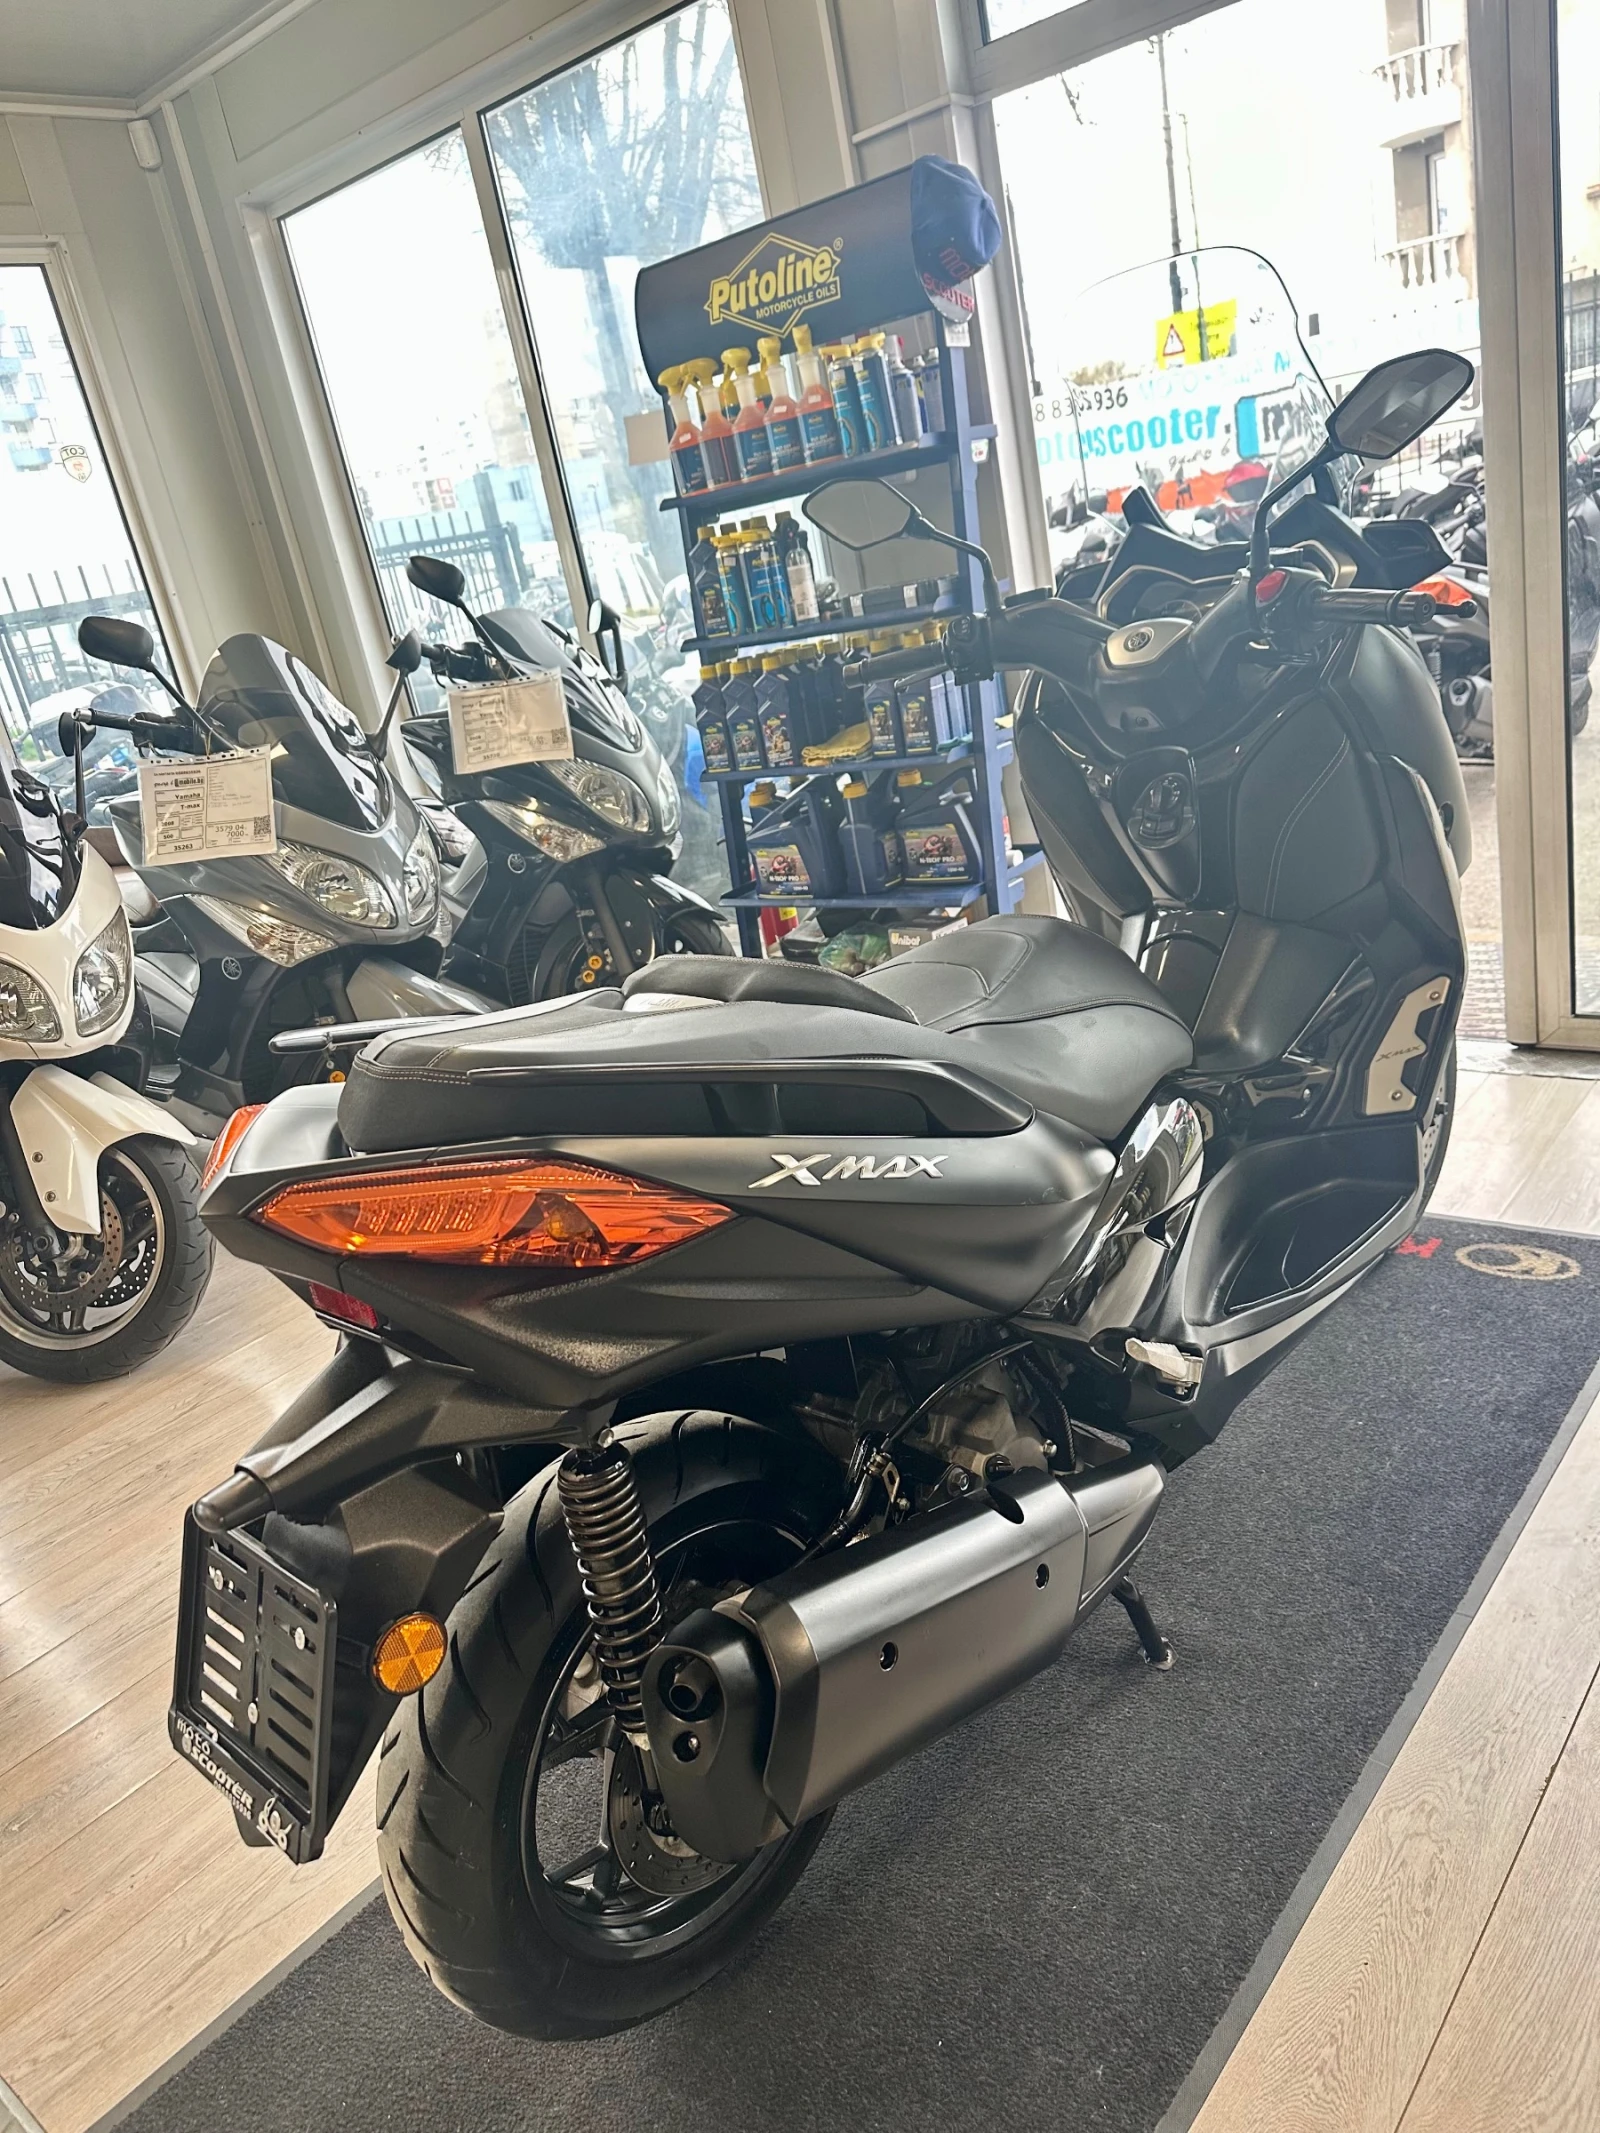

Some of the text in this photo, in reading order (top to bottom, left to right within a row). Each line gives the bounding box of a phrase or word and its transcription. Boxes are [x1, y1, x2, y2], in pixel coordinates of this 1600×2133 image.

[712, 250, 832, 320] Putoline
[756, 284, 836, 319] MOTORCYCLE OILS
[175, 792, 201, 800] Yamaha
[180, 803, 201, 811] T-max
[173, 843, 193, 851] 35263
[942, 855, 955, 864] PRO
[891, 932, 921, 946] Unibat
[190, 1746, 254, 1810] SCOOTER
